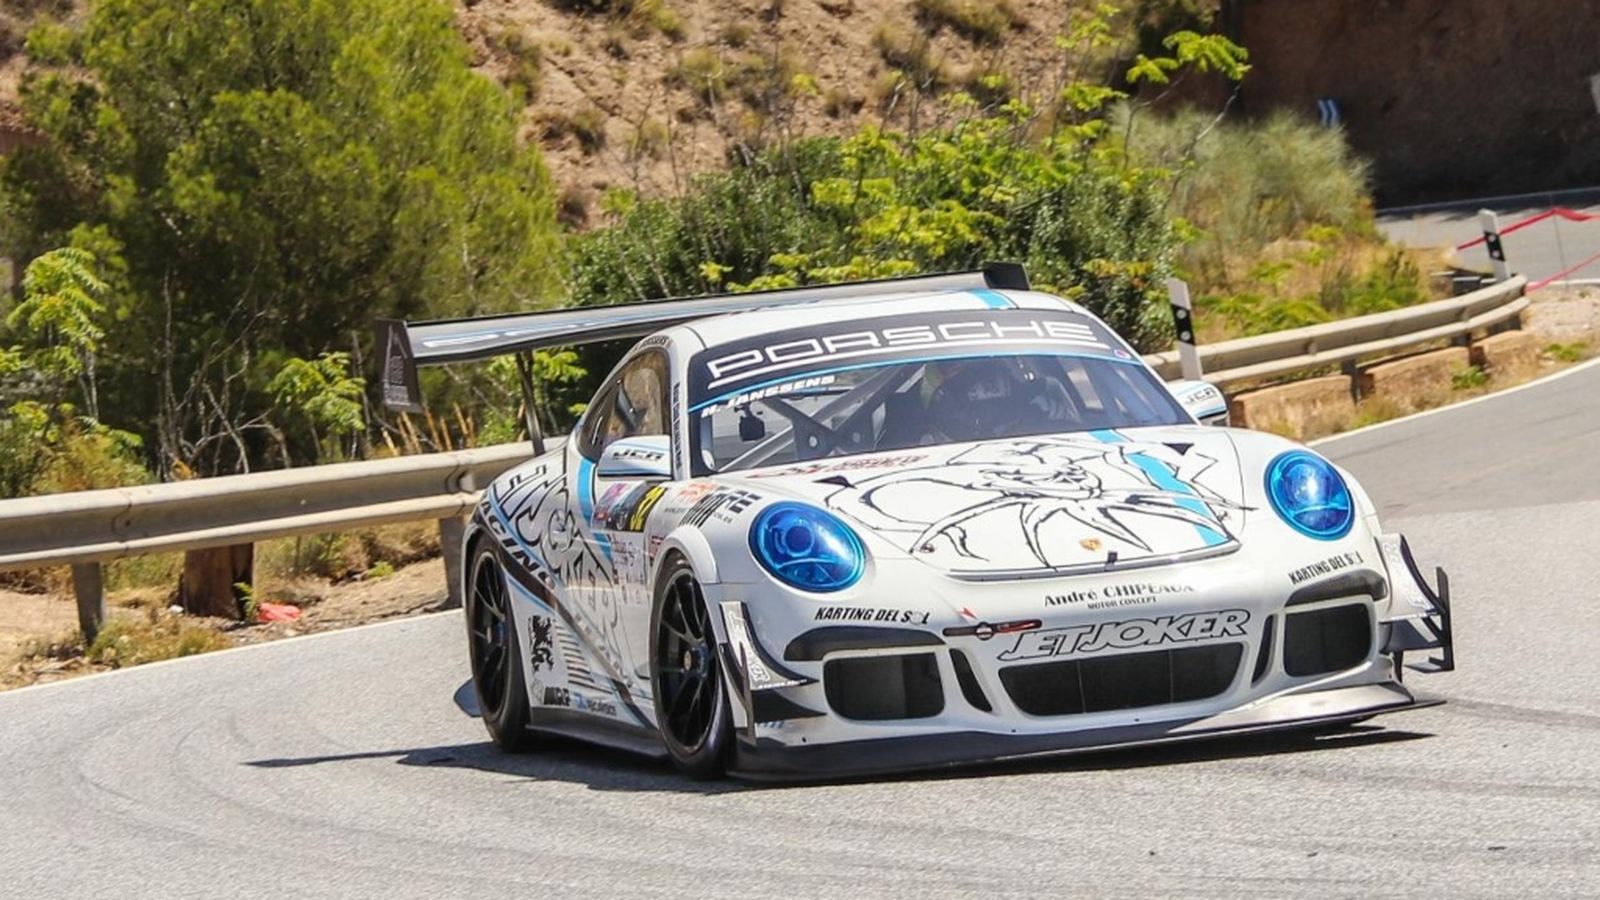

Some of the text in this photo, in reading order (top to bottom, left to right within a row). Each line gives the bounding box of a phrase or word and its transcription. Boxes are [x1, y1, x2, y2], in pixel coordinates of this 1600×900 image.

[706, 321, 1098, 379] PORSCHE
[727, 375, 835, 408] JANSSENS
[1287, 559, 1331, 585] KARTING
[1328, 555, 1348, 570] DEL
[1044, 590, 1097, 607] André
[1087, 596, 1157, 610] MOTOR CONCEPT
[815, 606, 874, 620] KARTING
[874, 608, 900, 622] DEL
[1000, 608, 1251, 662] JETJOKER
